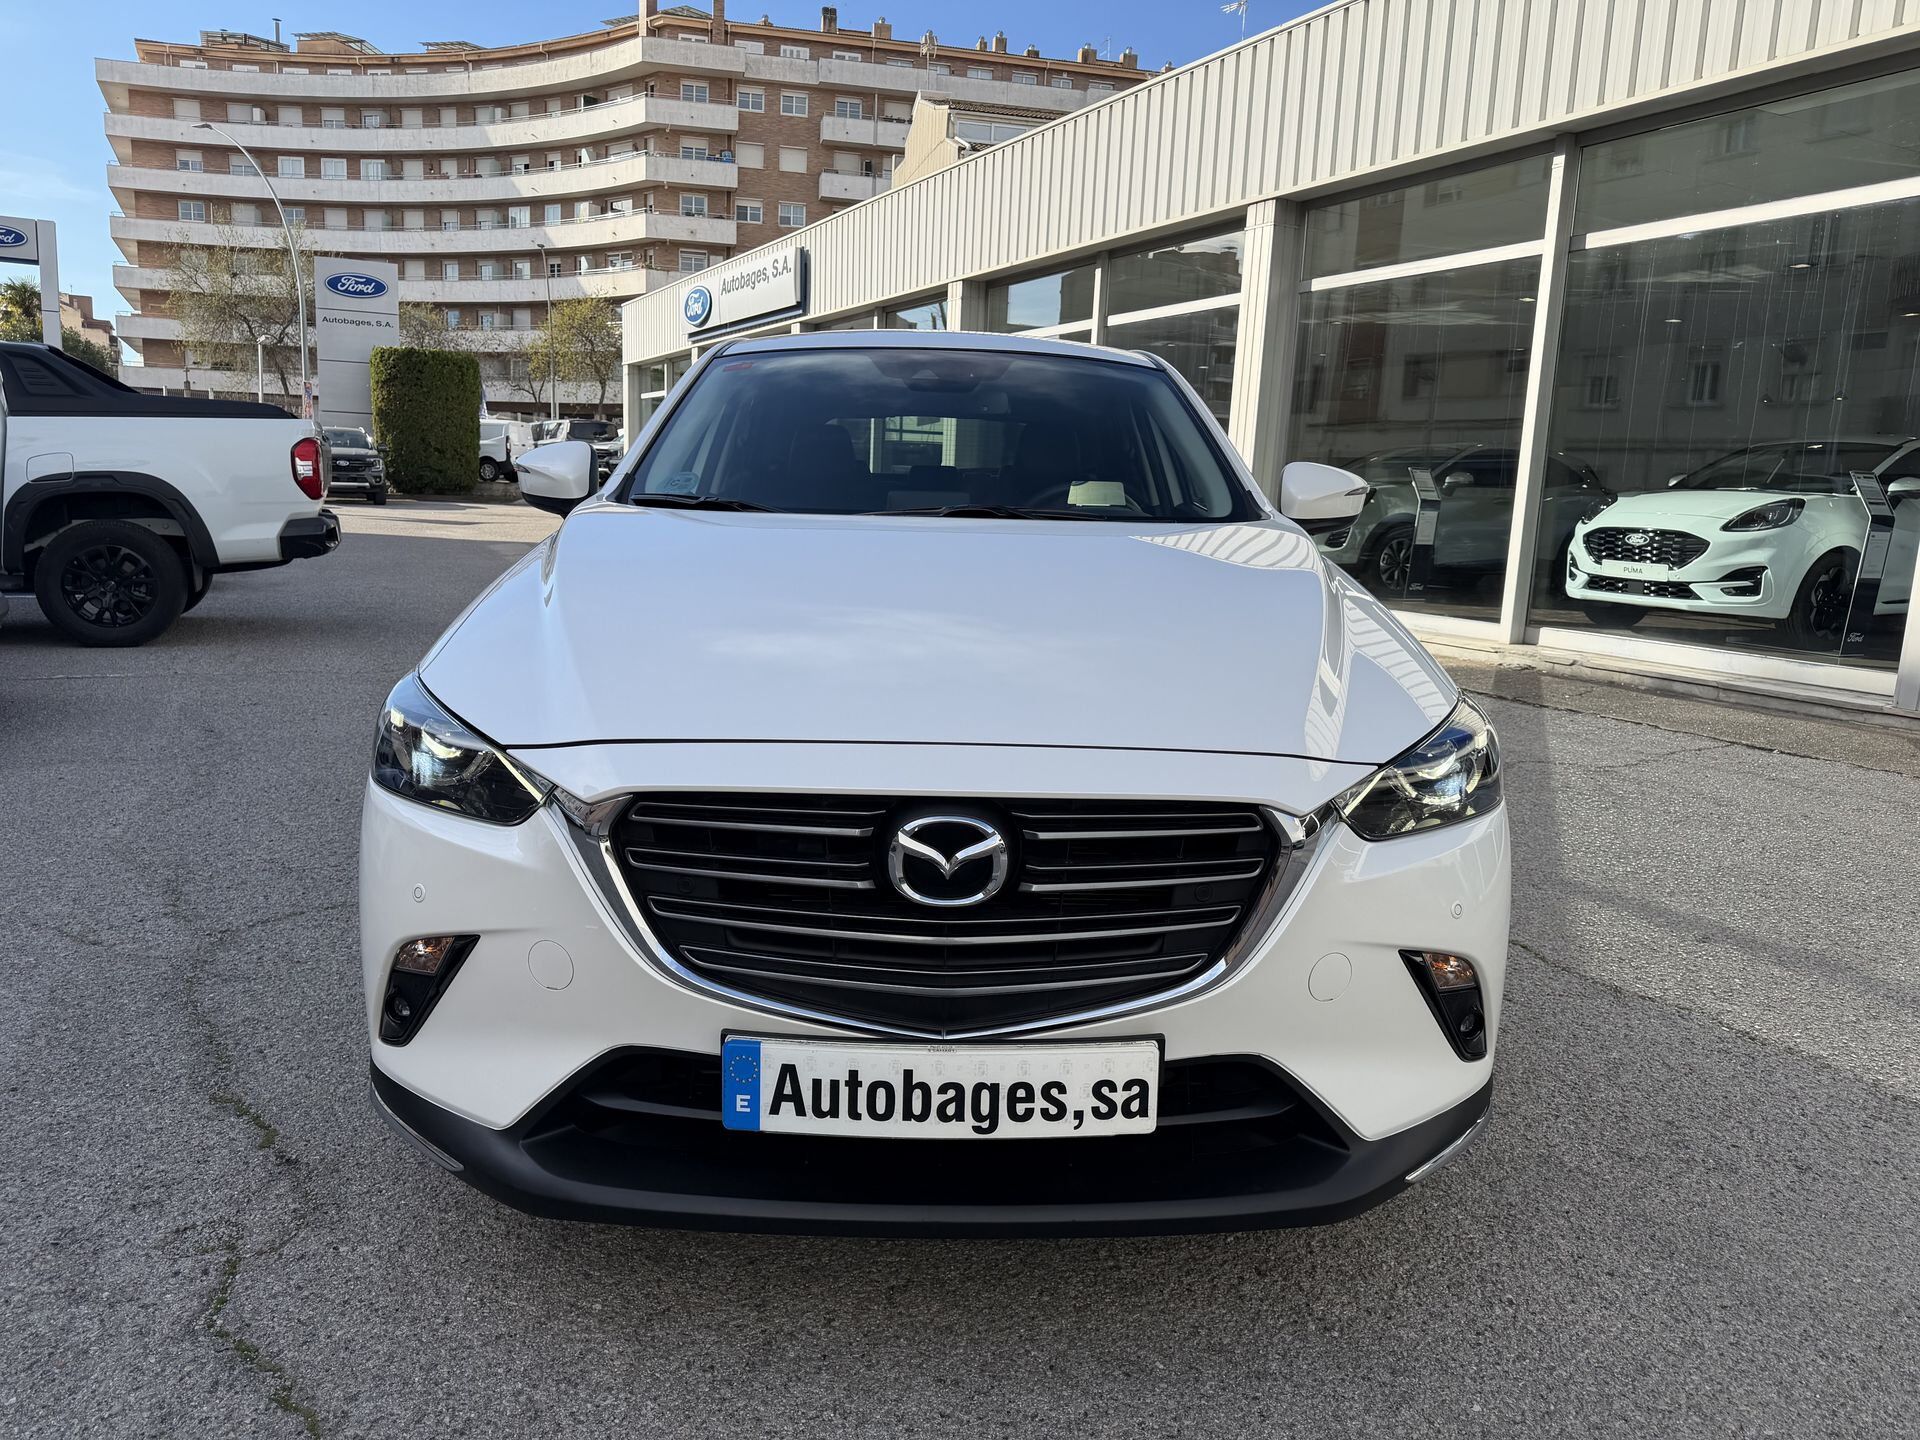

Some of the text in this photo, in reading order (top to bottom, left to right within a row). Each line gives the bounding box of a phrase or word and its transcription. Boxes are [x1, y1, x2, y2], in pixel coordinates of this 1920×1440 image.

[337, 275, 376, 293] Ford
[721, 255, 792, 296] Autobages, S.A.
[687, 292, 704, 318] Ford
[322, 316, 394, 329] Autobages, S.A.
[1847, 632, 1865, 643] Ford
[735, 1094, 751, 1113] E
[768, 1063, 1151, 1135] Autobages,sa
